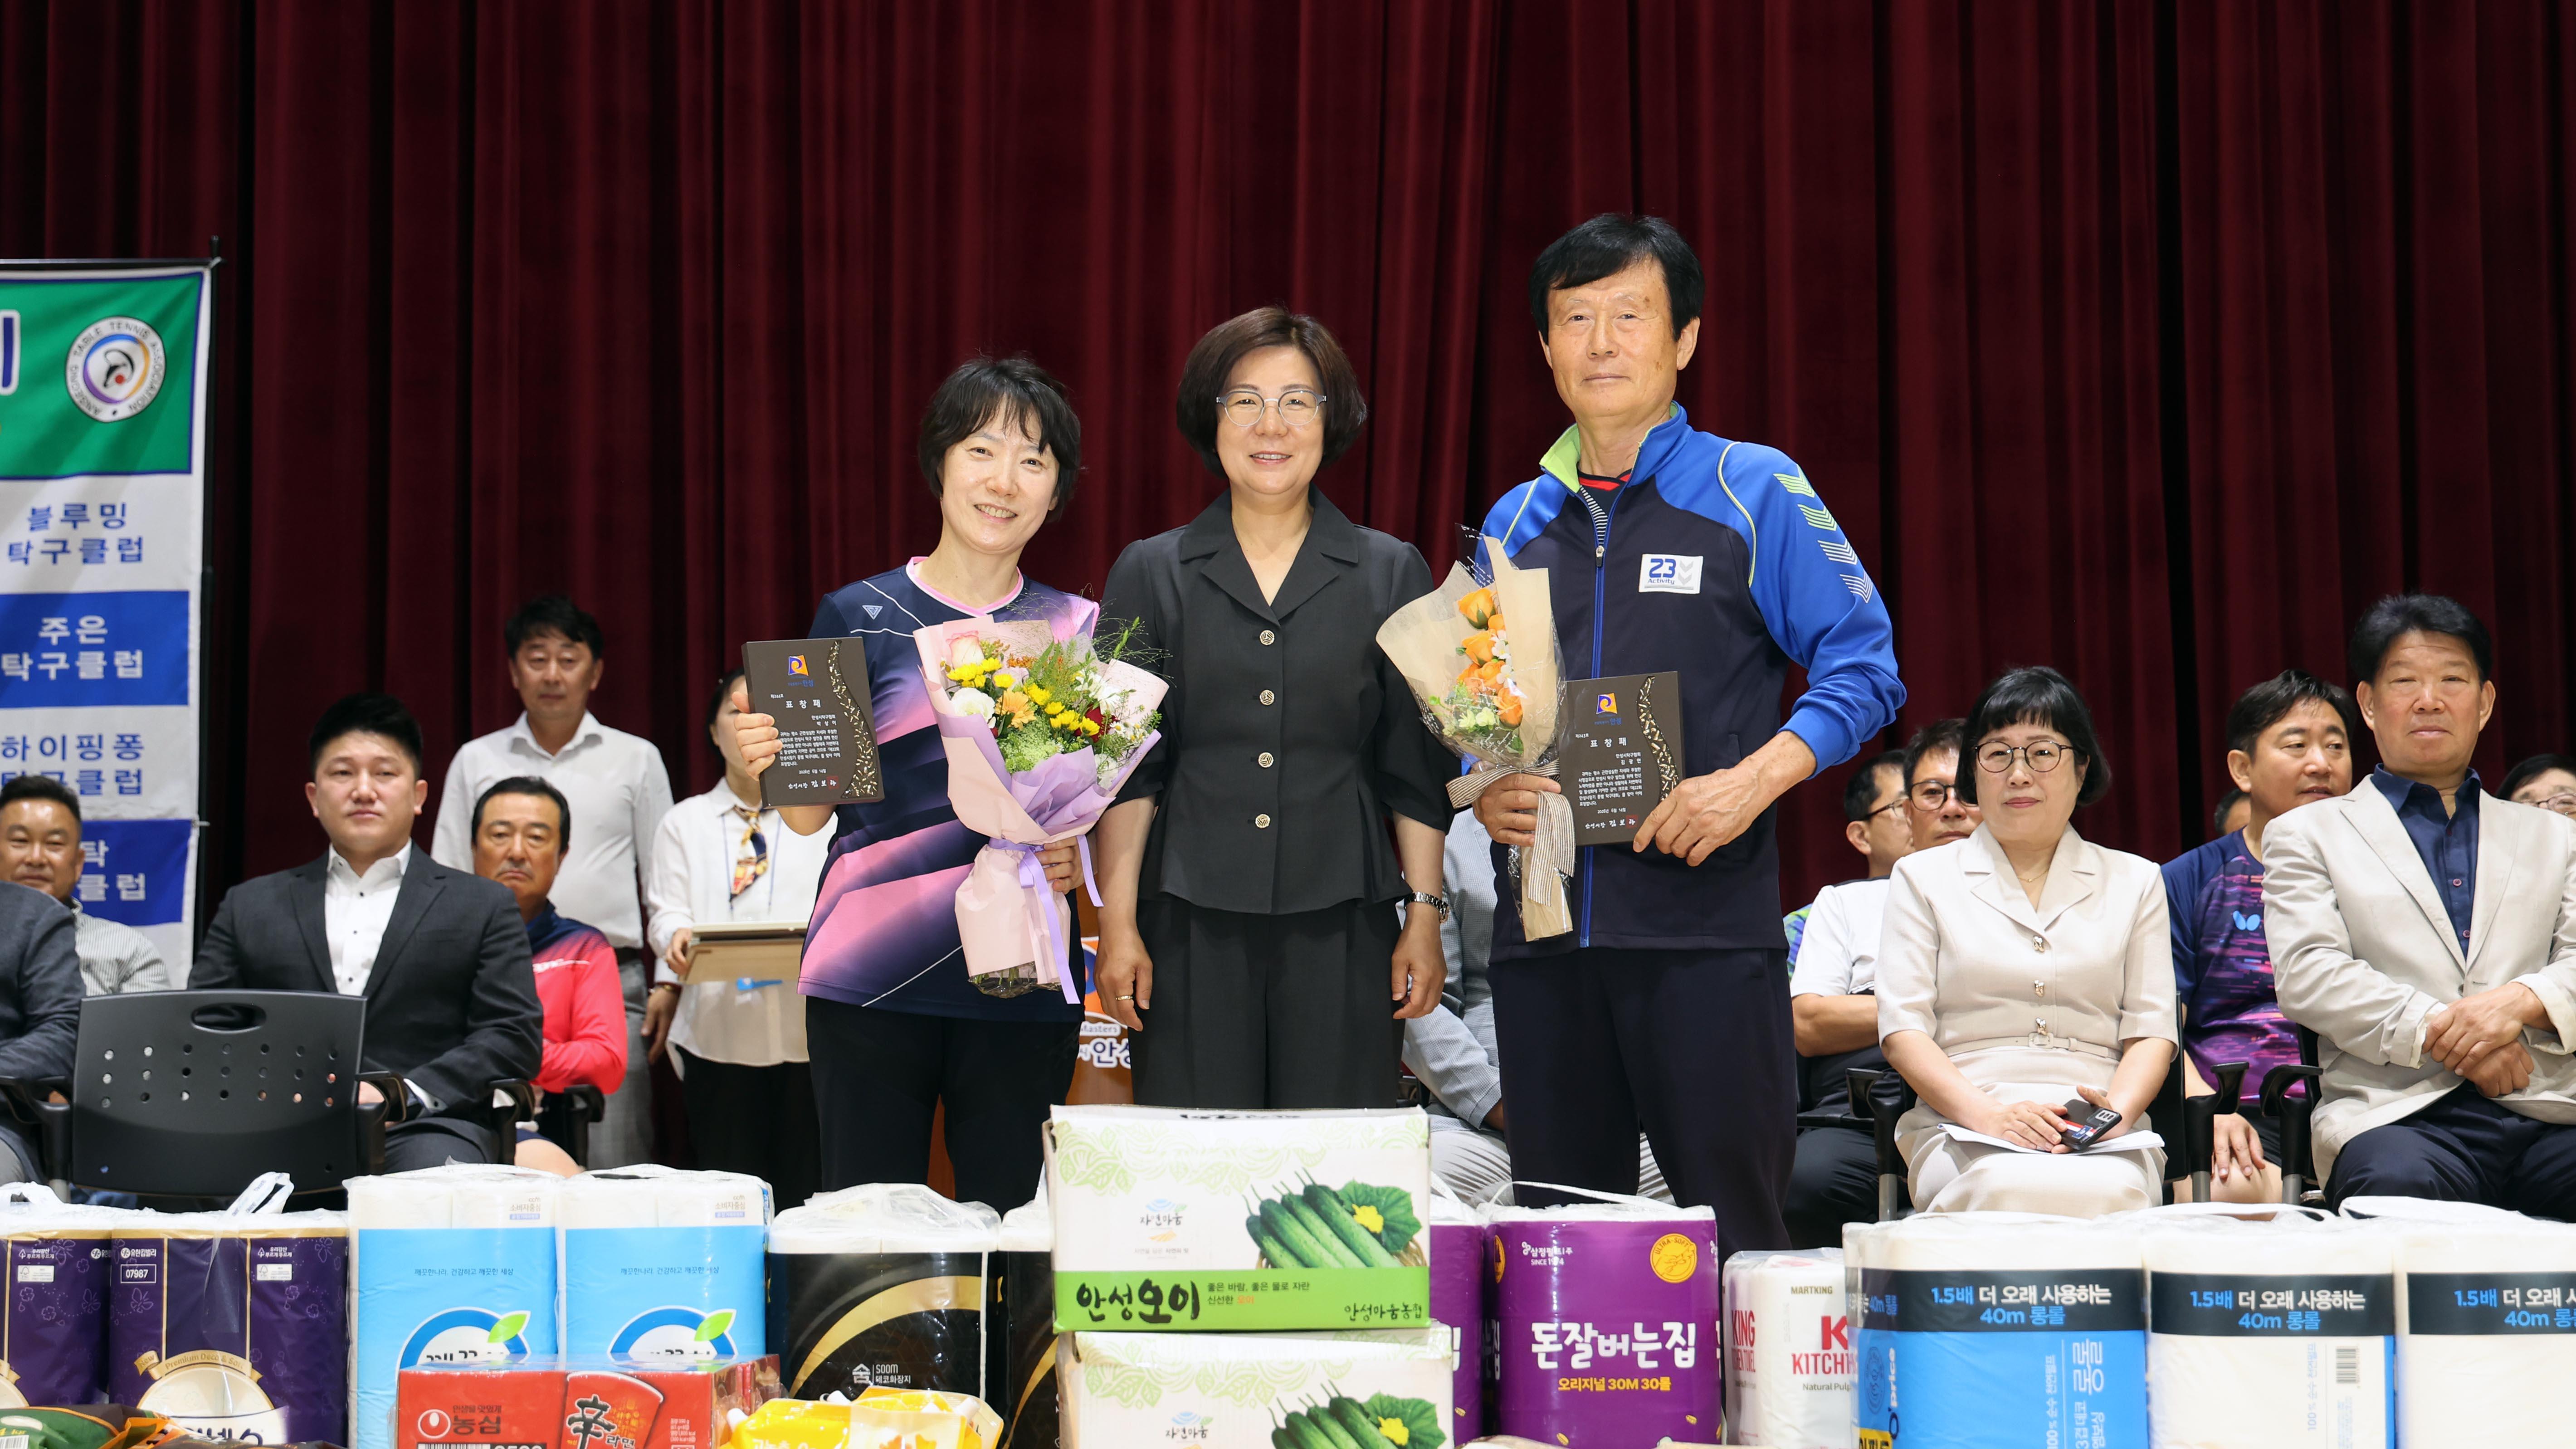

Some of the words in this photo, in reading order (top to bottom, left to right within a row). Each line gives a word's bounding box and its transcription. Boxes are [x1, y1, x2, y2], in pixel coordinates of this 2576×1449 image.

[26, 502, 127, 531] 블루밍
[7, 537, 144, 566] 탁구클럽
[1649, 558, 1676, 578] 23
[39, 615, 108, 644] 주은
[1, 649, 143, 681] 탁구클럽
[1, 733, 144, 762] 하이핑퐁
[131, 1249, 156, 1257] 유한킴벌리
[126, 1269, 148, 1278] 07987
[1208, 1282, 1224, 1292] 좋은
[1251, 1282, 1268, 1292] 좋은
[1293, 1281, 1310, 1291] 자란
[1931, 1285, 1974, 1306] 1.5배
[1979, 1285, 1996, 1307] 더
[2001, 1284, 2038, 1306] 오래
[2041, 1283, 2112, 1306] 사용하는
[1208, 1295, 1234, 1305] 신선한
[2190, 1290, 2233, 1310] 1.5배
[2238, 1290, 2256, 1311] 더
[2259, 1290, 2294, 1311] 오래
[2297, 1289, 2366, 1311] 사용하는
[2454, 1288, 2498, 1308] 1.5배
[2503, 1288, 2521, 1308] 더
[2525, 1287, 2561, 1308] 오래
[1980, 1308, 2025, 1324] 40m
[2029, 1305, 2067, 1326] 롱롤
[2238, 1313, 2281, 1329] 40m
[2286, 1311, 2321, 1331] 롱롤
[2503, 1310, 2550, 1327] 40m
[1732, 1309, 1756, 1347] KING
[1531, 1322, 1696, 1369] 돈잘버는집
[165, 1354, 199, 1370] Premium
[200, 1353, 219, 1361] Deco
[875, 1375, 911, 1384] 데코화장지
[1558, 1376, 1605, 1391] 오리지널
[1608, 1378, 1639, 1390] 30M
[1641, 1376, 1671, 1391] 30롤
[1803, 1382, 1833, 1391] Natural
[453, 1415, 502, 1435] 농심
